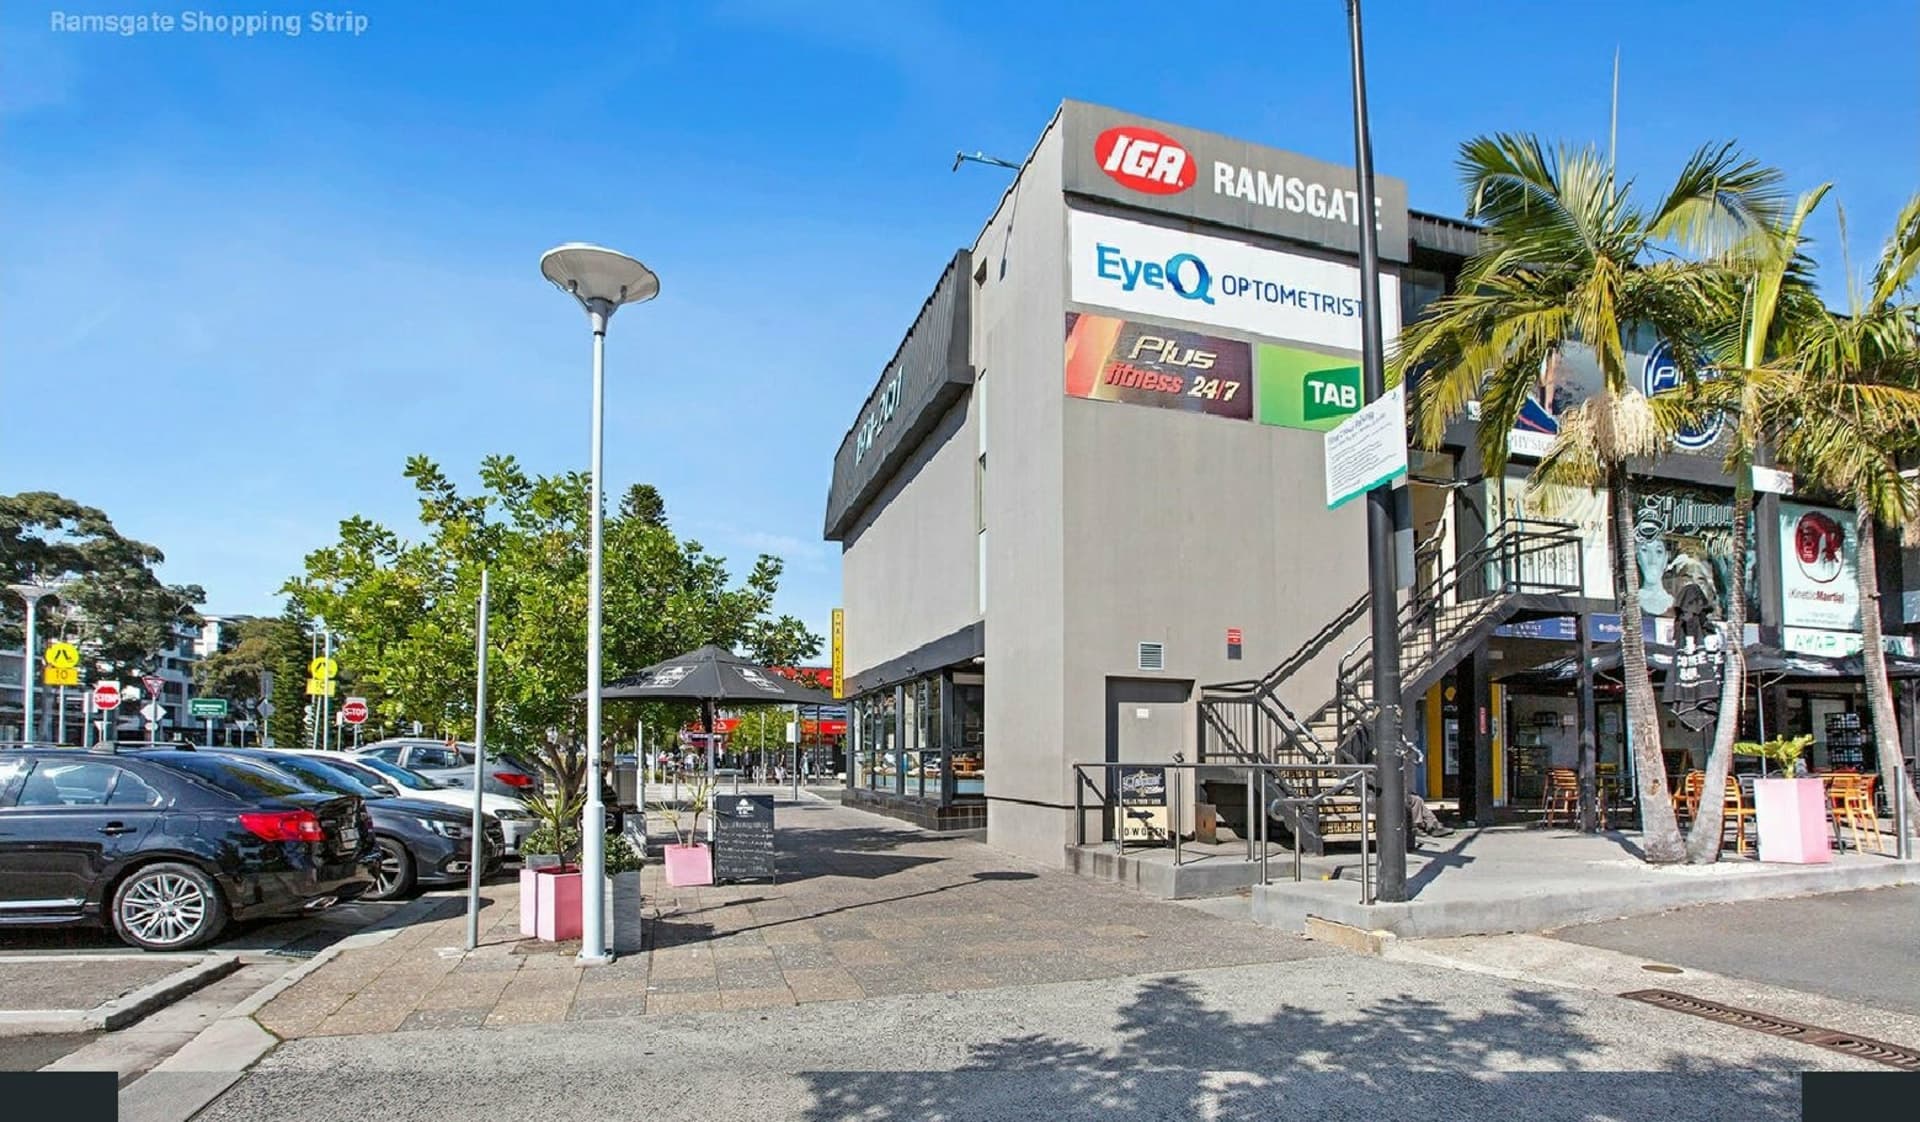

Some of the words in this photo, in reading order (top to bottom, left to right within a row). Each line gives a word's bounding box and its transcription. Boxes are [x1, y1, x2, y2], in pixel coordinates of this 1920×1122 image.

[1104, 134, 1184, 187] IGA
[1213, 161, 1383, 230] RAMSGATE
[1096, 242, 1215, 306] EyeQ
[1128, 335, 1217, 369] Plus
[1104, 360, 1184, 394] fitness
[1187, 376, 1240, 402] 24/7
[1308, 380, 1357, 409] TAB
[343, 707, 367, 717] STOP
